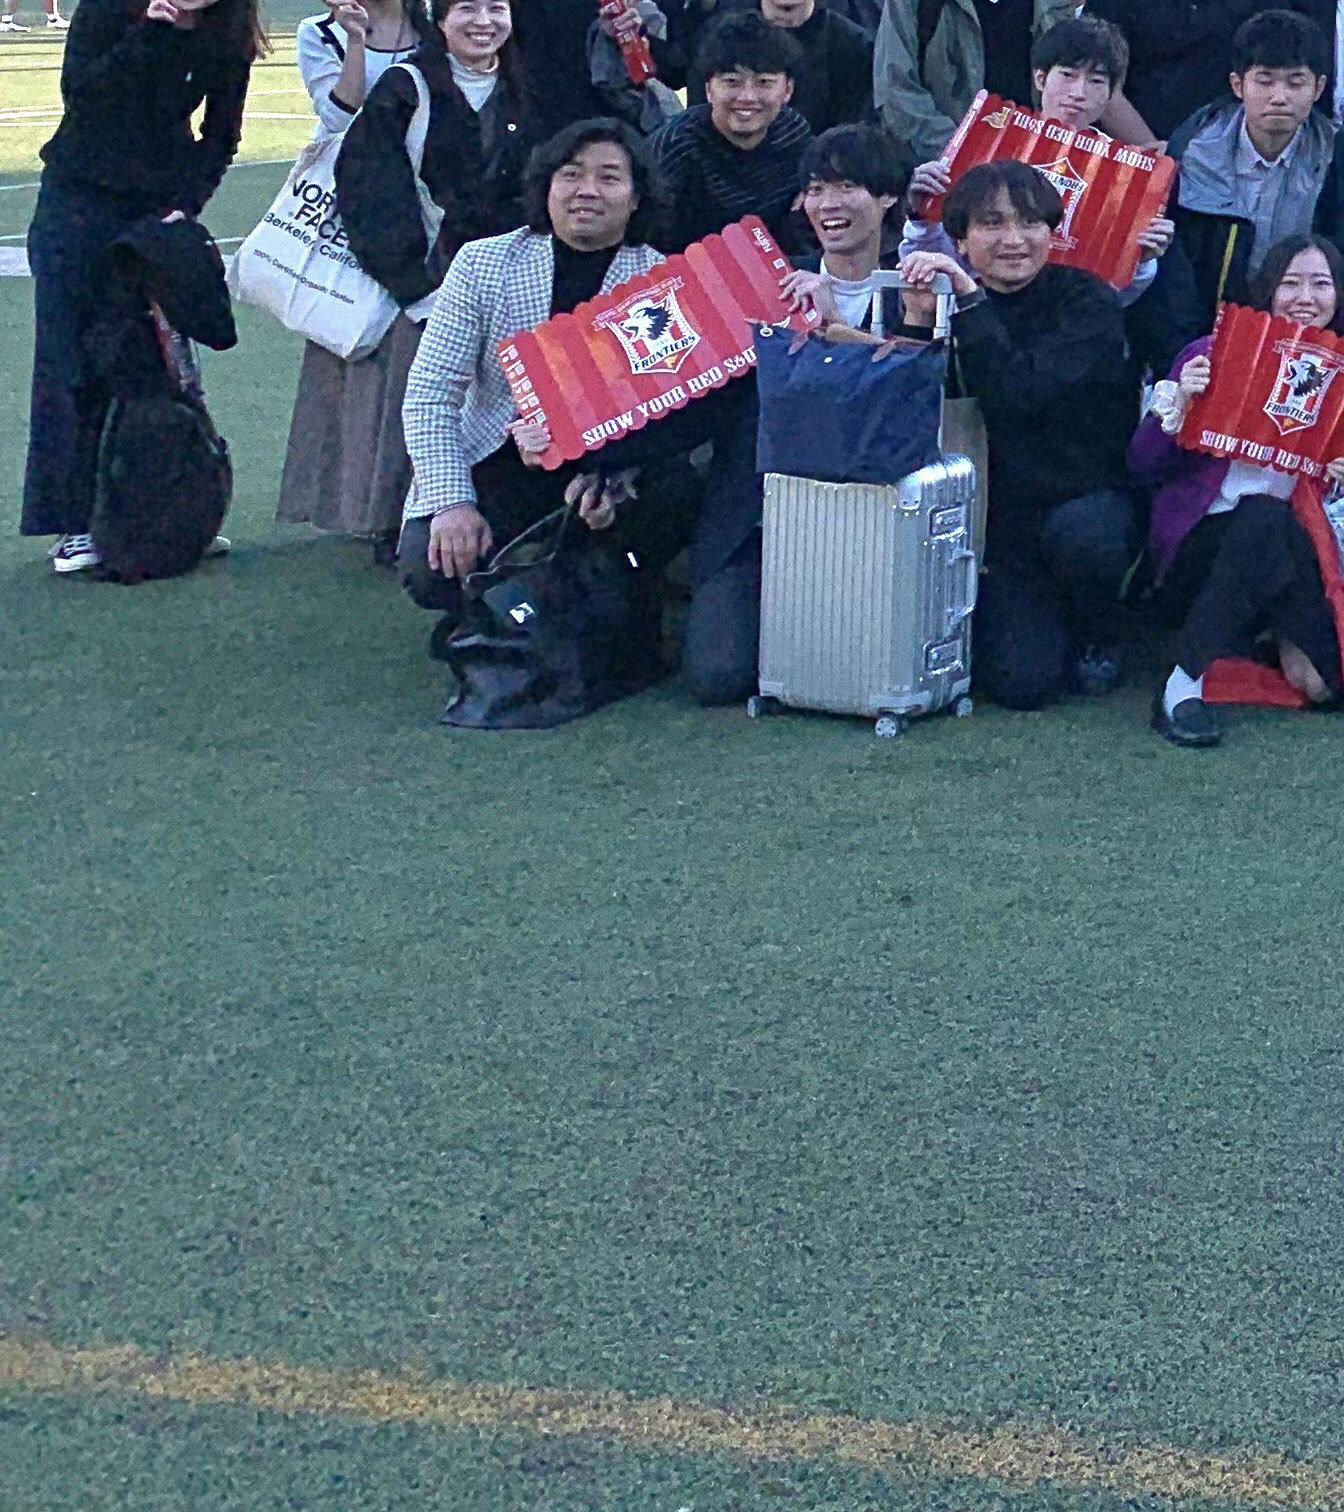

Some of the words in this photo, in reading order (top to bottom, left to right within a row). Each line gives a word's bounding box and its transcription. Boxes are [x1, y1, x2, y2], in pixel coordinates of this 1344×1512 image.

[1045, 125, 1074, 144] RED
[1074, 134, 1111, 160] YOUR
[1113, 148, 1157, 172] SHOW
[293, 180, 335, 214] NOR
[294, 203, 348, 247] FACE
[634, 335, 696, 371] FRONTIERS
[581, 409, 635, 447] SHOW
[637, 386, 688, 420] YOUR
[686, 365, 724, 395] RED
[723, 345, 757, 375] SOU
[1266, 402, 1316, 423] FRONTIERS
[1200, 430, 1240, 453] SHOW
